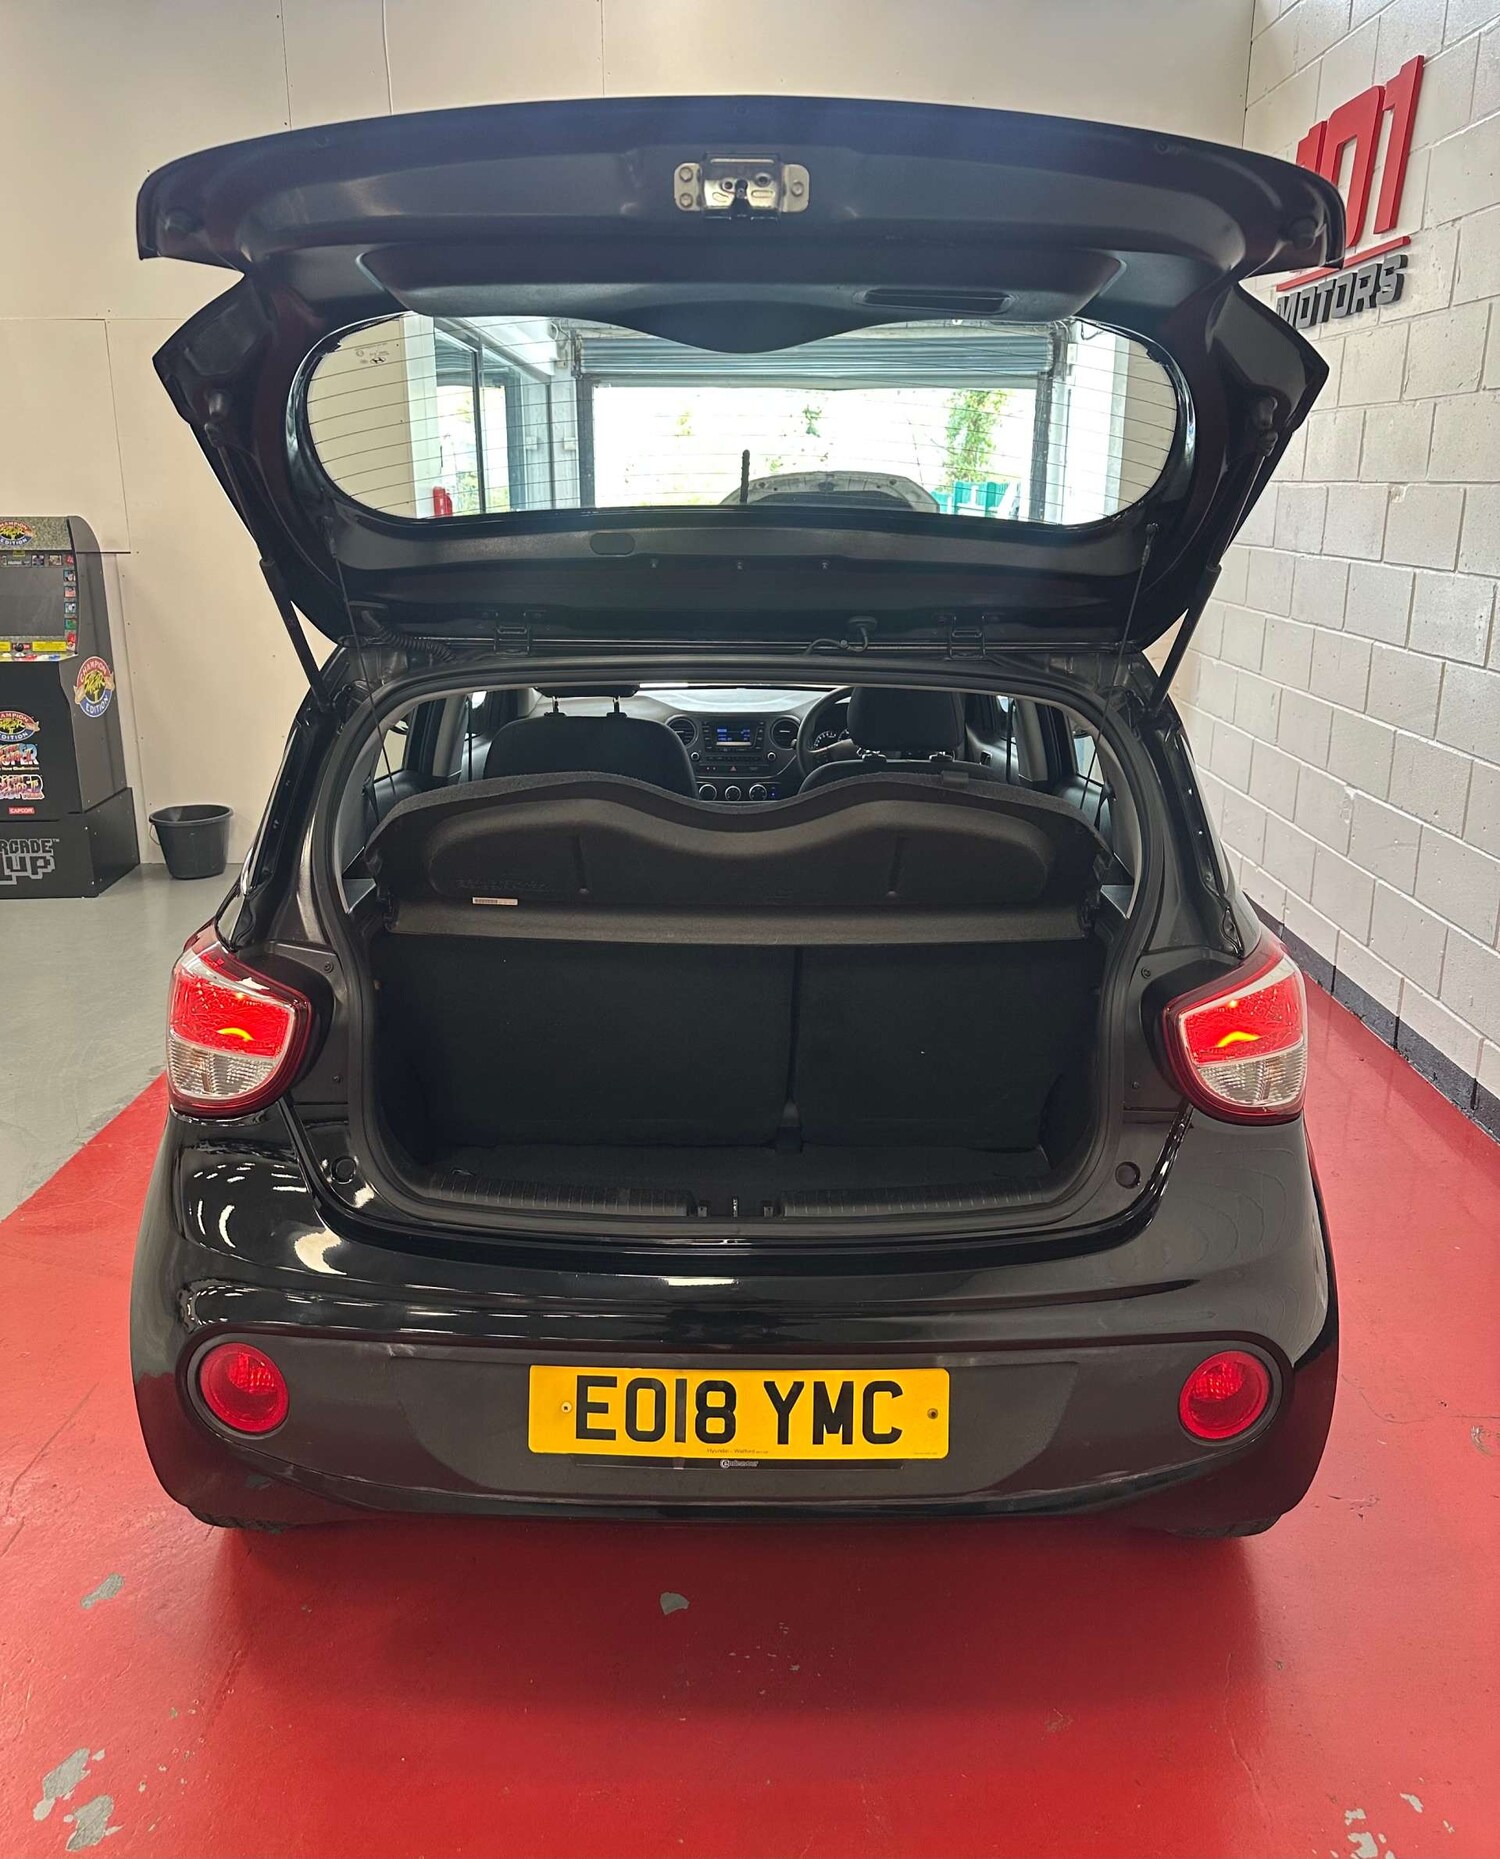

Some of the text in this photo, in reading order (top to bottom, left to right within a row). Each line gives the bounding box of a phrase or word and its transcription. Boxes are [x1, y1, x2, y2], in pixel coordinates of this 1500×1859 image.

[1276, 254, 1408, 329] MOTORS
[79, 659, 109, 683] CHAMPION
[85, 694, 109, 714] EDITION
[0, 712, 29, 723] AMPION
[0, 731, 29, 741] DITION
[0, 838, 54, 855] RCADE
[576, 1375, 903, 1446] EO18 YMC
